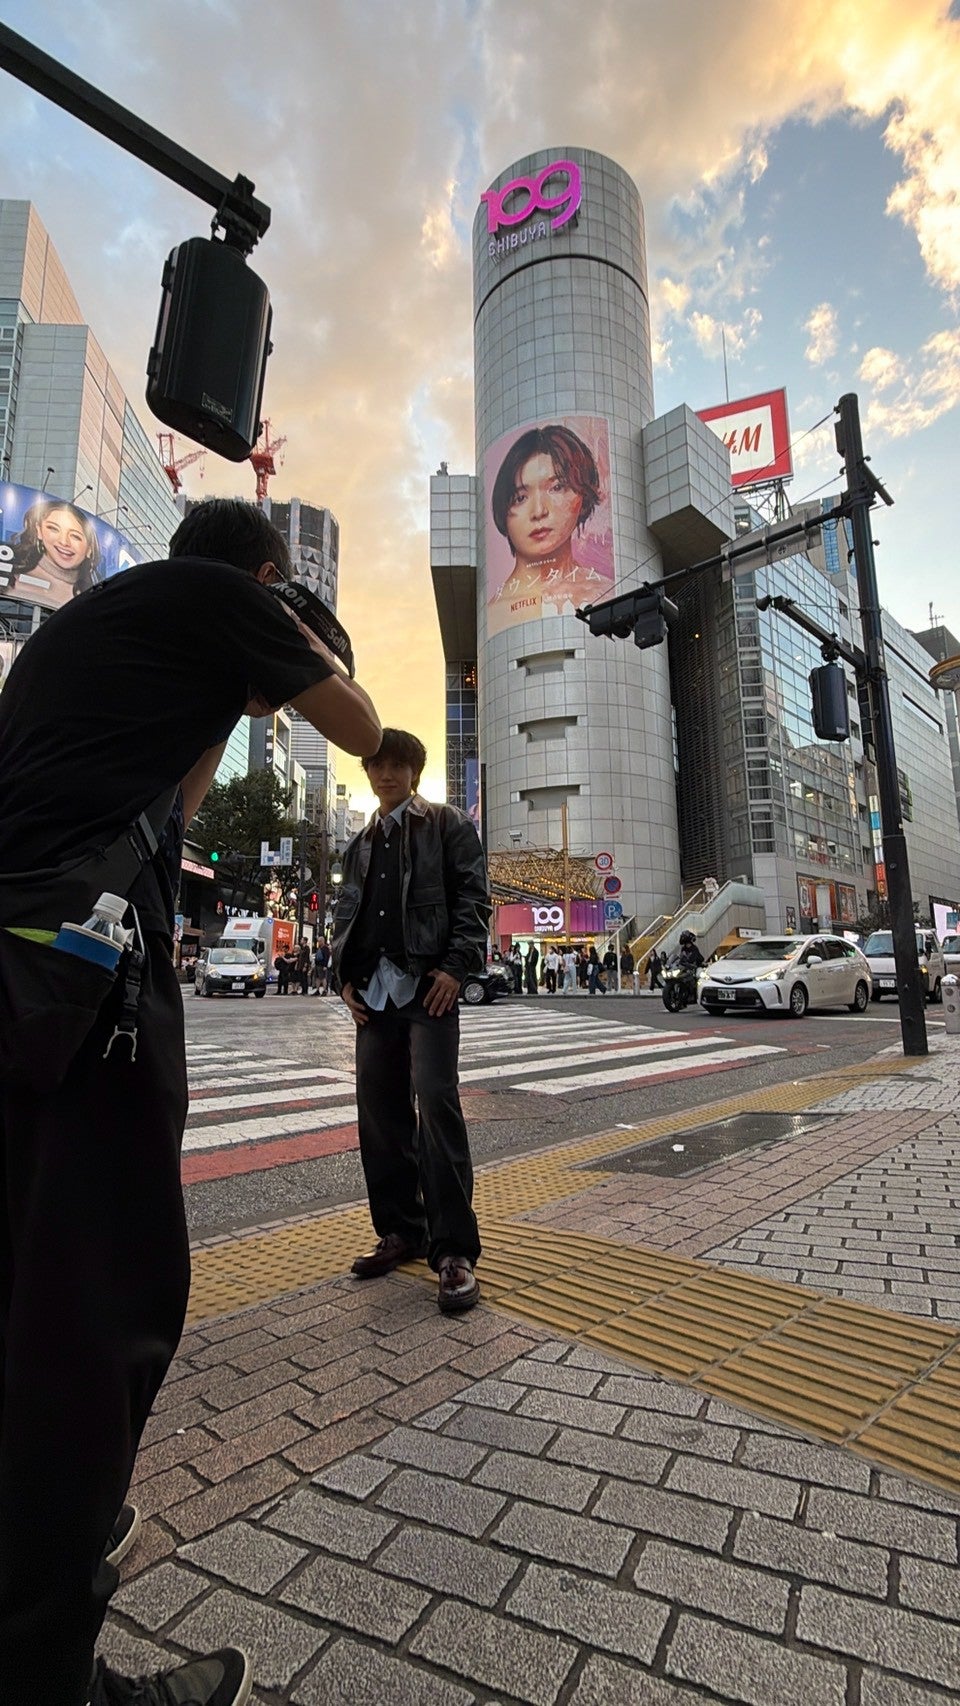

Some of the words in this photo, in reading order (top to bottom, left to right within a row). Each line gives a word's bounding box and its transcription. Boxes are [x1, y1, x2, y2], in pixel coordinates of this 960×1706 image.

[481, 159, 582, 233] 109
[488, 221, 546, 256] SHIBUYA
[511, 597, 536, 612] NETFLIX
[327, 627, 348, 653] NPS
[532, 906, 564, 932] 109
